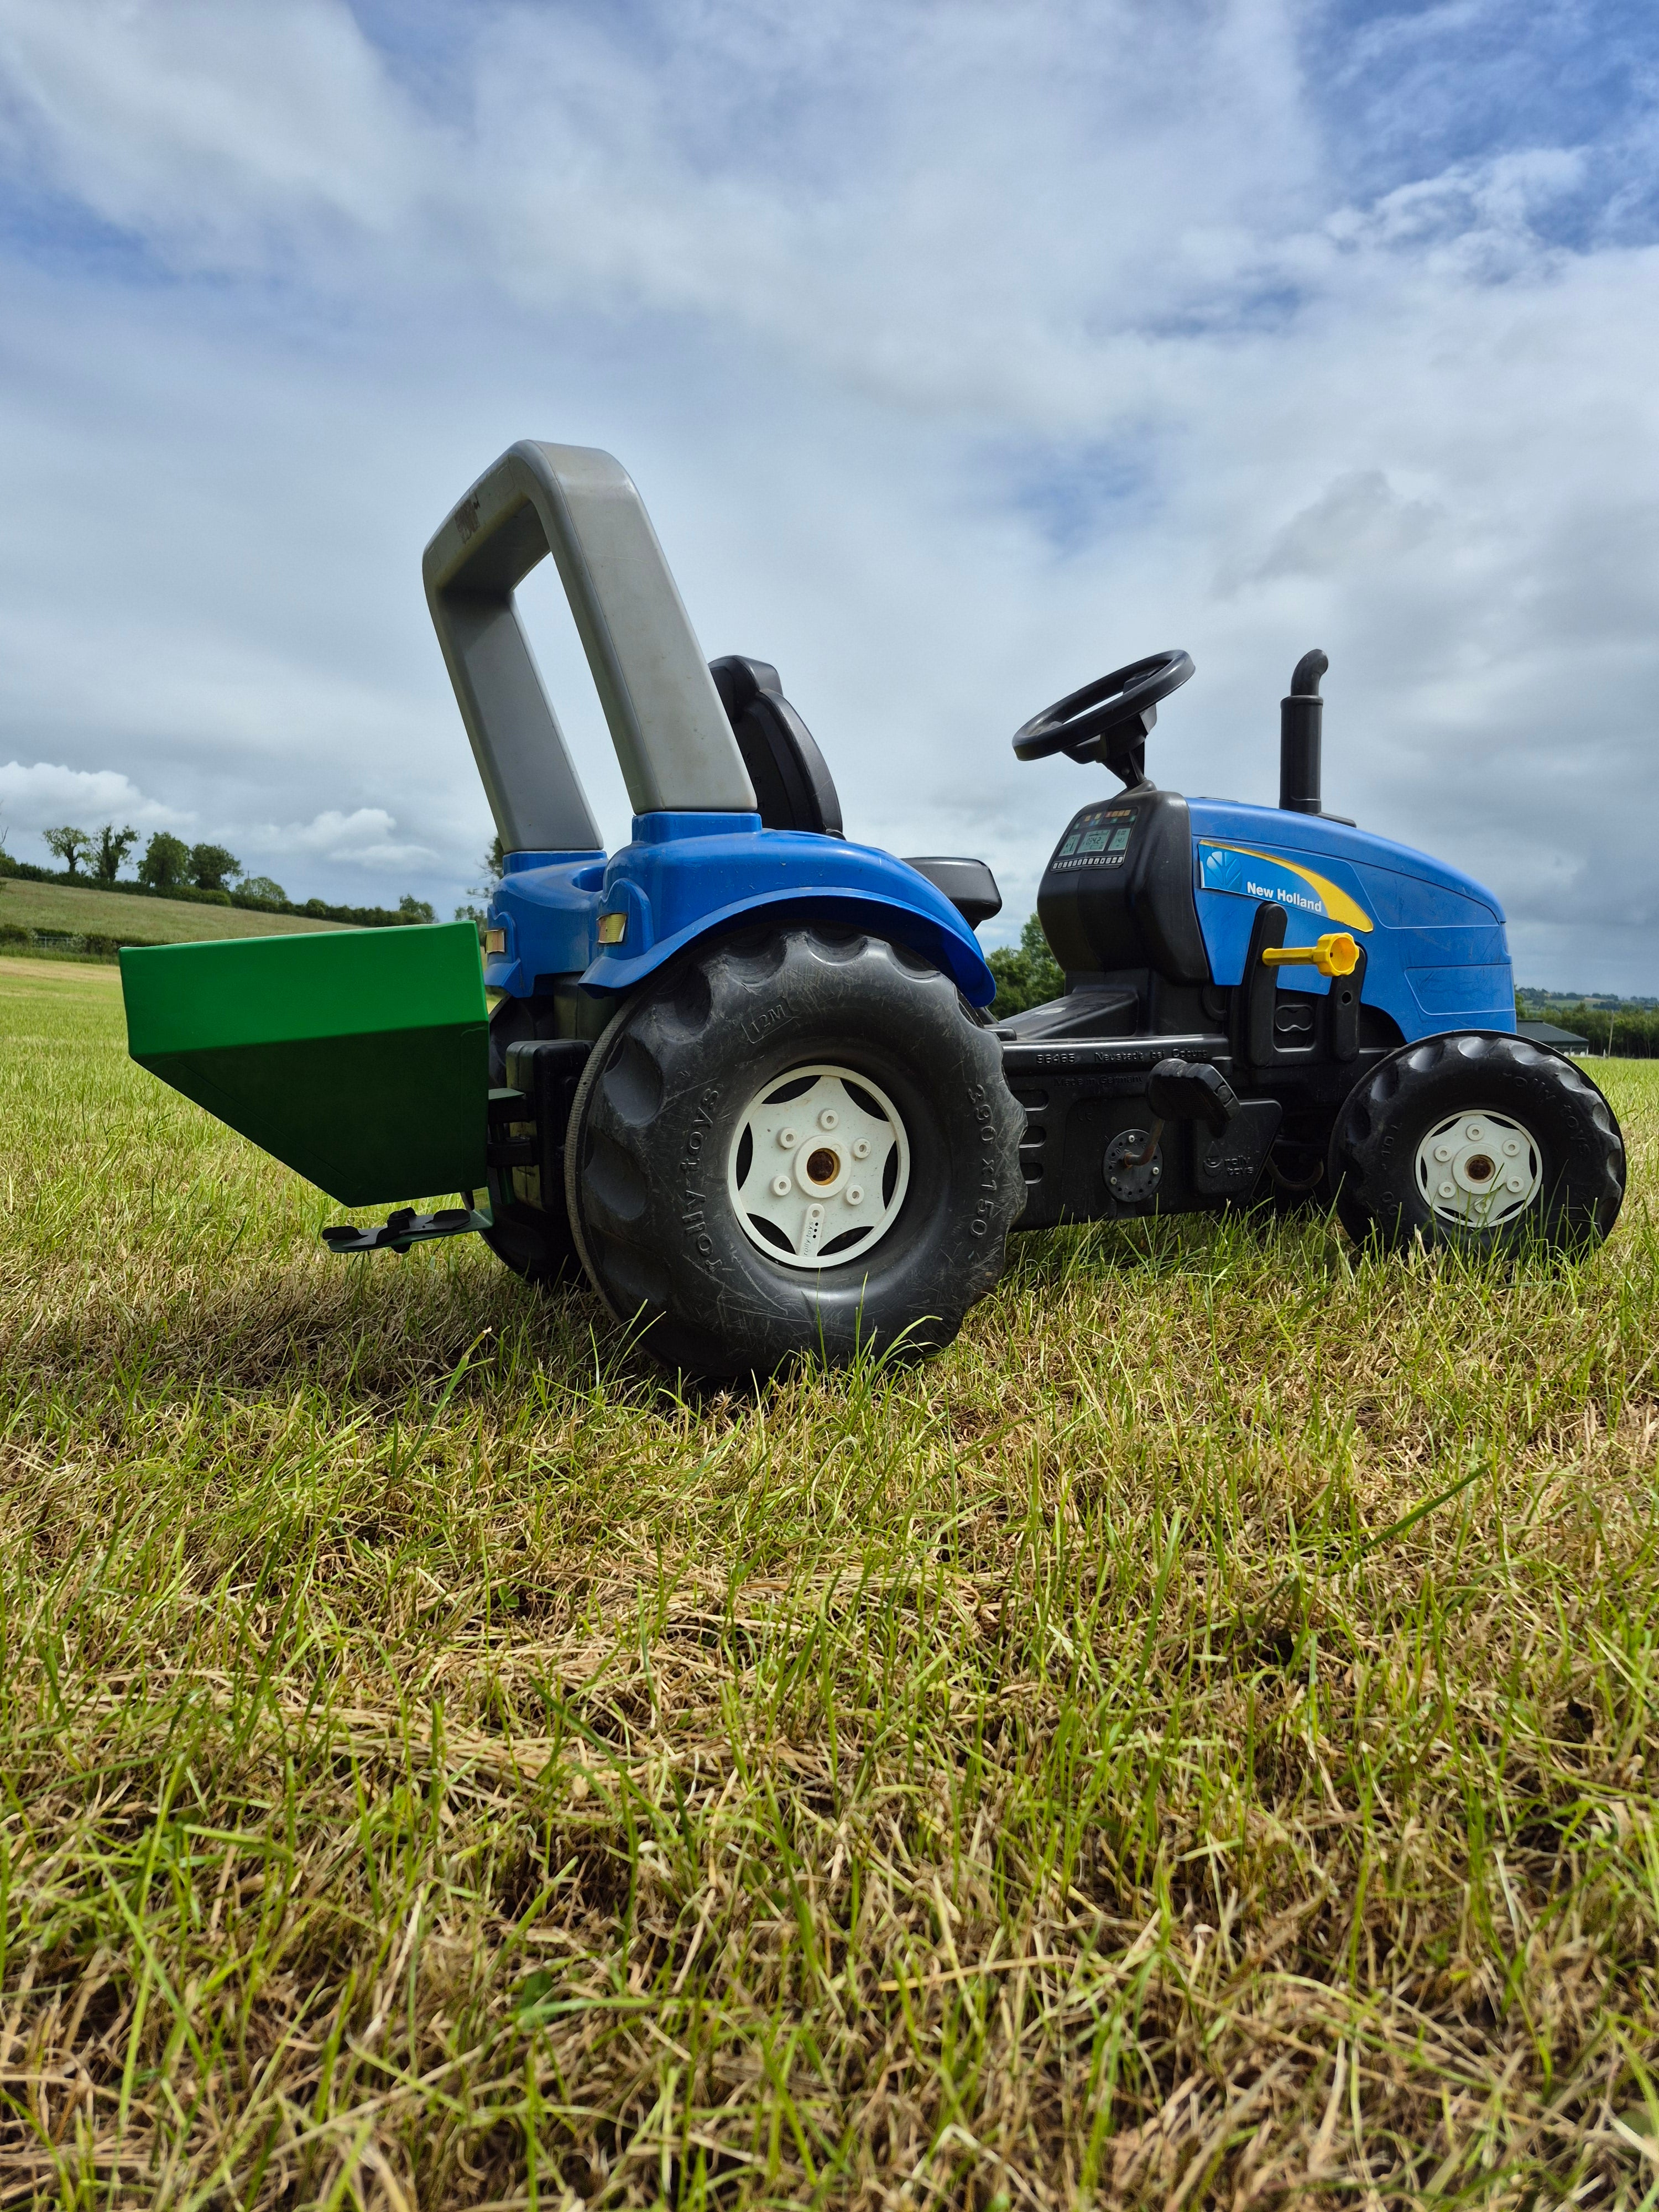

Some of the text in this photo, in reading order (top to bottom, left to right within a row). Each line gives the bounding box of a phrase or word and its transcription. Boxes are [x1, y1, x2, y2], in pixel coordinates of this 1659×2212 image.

[1246, 881, 1322, 912] New Holland
[751, 1004, 786, 1034] 12M
[1036, 1048, 1208, 1065] 96465 Neustadt bei Coburg
[1053, 1077, 1084, 1087] Made
[1099, 1075, 1143, 1084] Germany
[680, 1087, 722, 1274] rolly toys
[806, 1221, 814, 1238] toys
